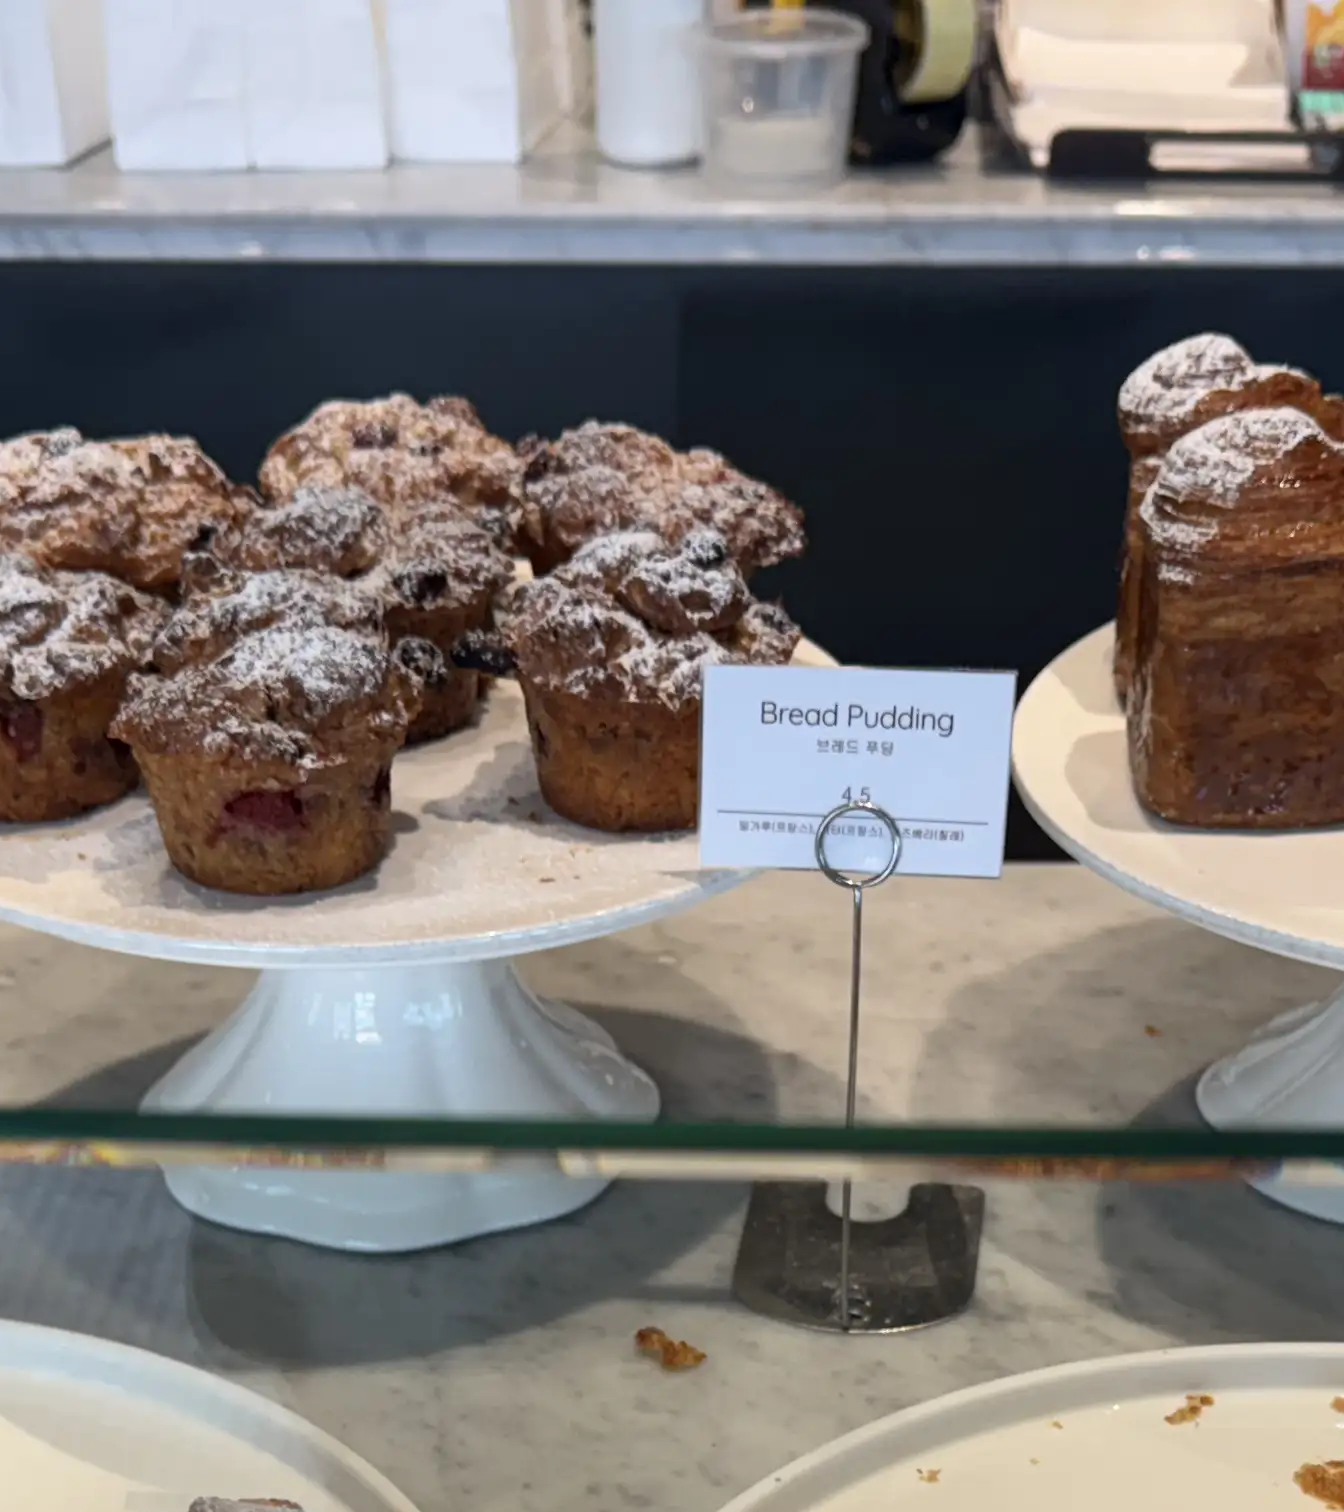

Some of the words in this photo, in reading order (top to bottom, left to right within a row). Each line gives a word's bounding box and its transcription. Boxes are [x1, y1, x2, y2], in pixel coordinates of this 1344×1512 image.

[760, 700, 839, 727] Bread
[847, 703, 955, 738] Pudding
[816, 739, 859, 754] 브레드
